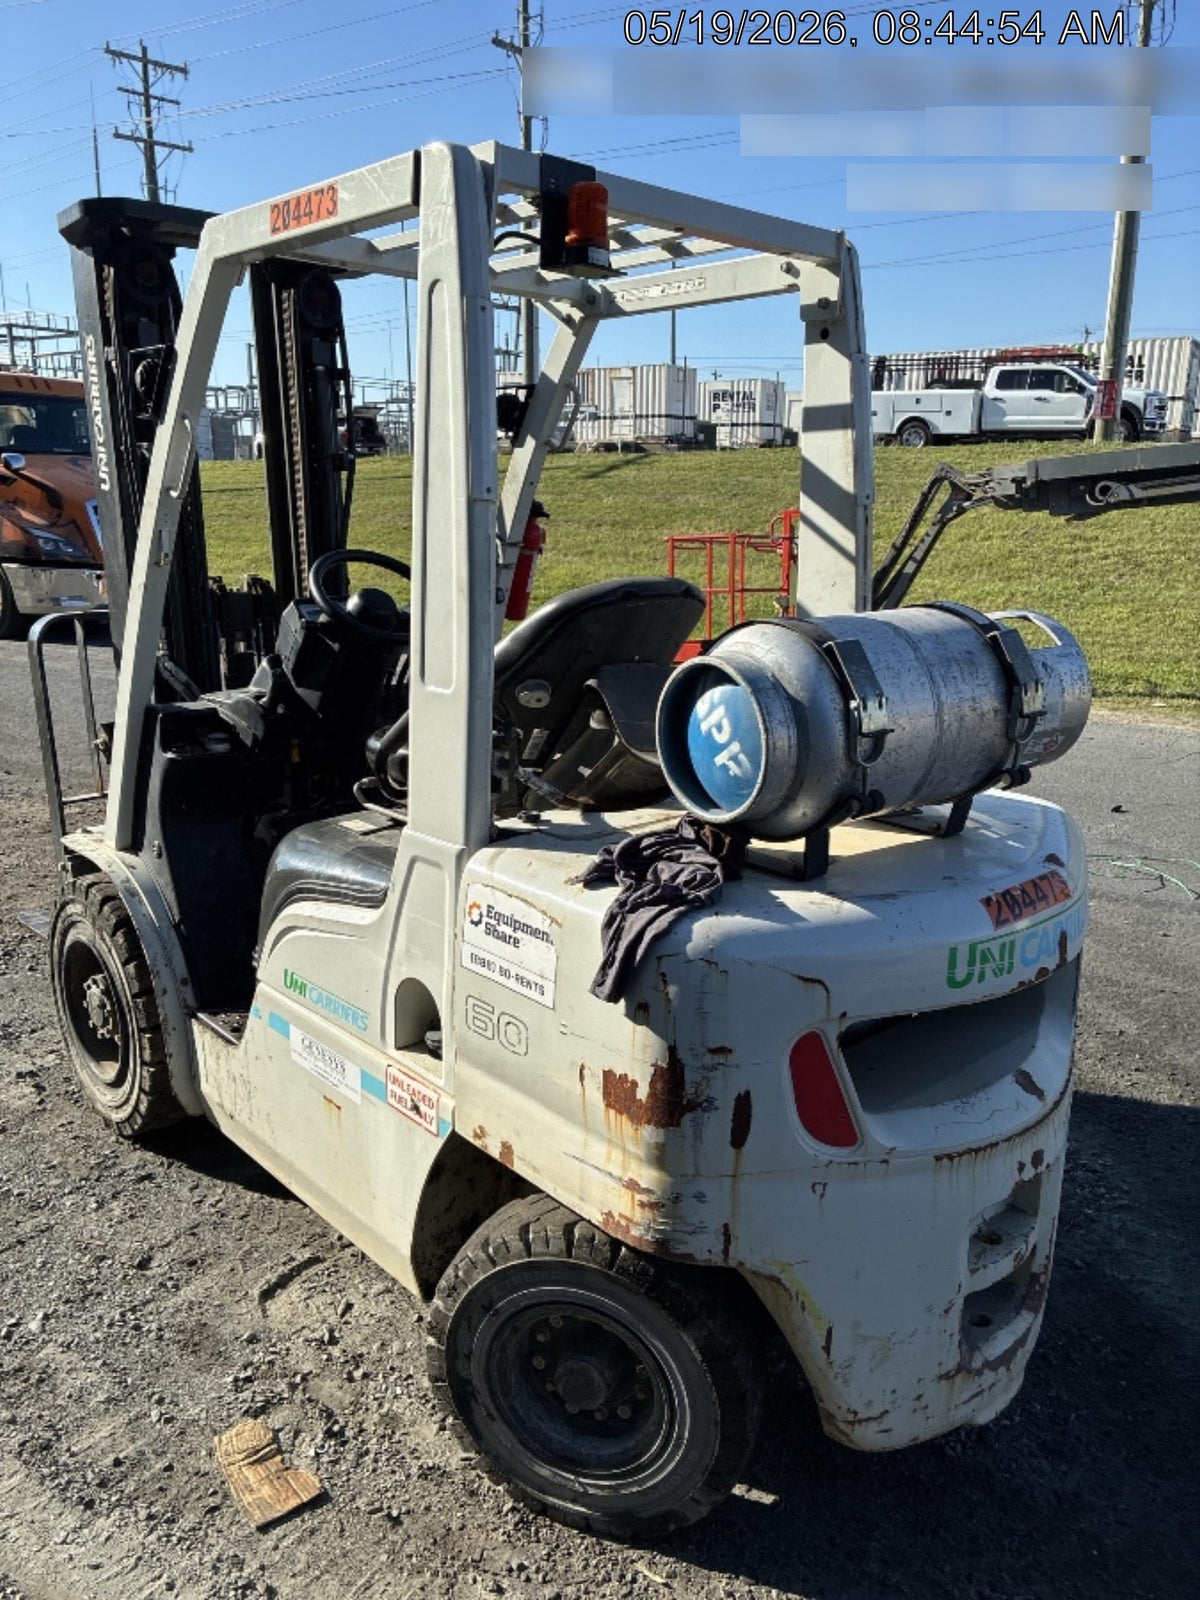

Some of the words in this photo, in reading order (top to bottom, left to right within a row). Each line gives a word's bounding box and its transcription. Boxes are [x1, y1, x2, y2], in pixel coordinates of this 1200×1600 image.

[271, 184, 337, 234] 204473
[712, 390, 756, 403] RENTAL
[485, 922, 520, 949] Share
[284, 968, 368, 1032] UNICARRIERS
[389, 1072, 435, 1110] UNLEADED
[390, 1089, 410, 1110] FUEL
